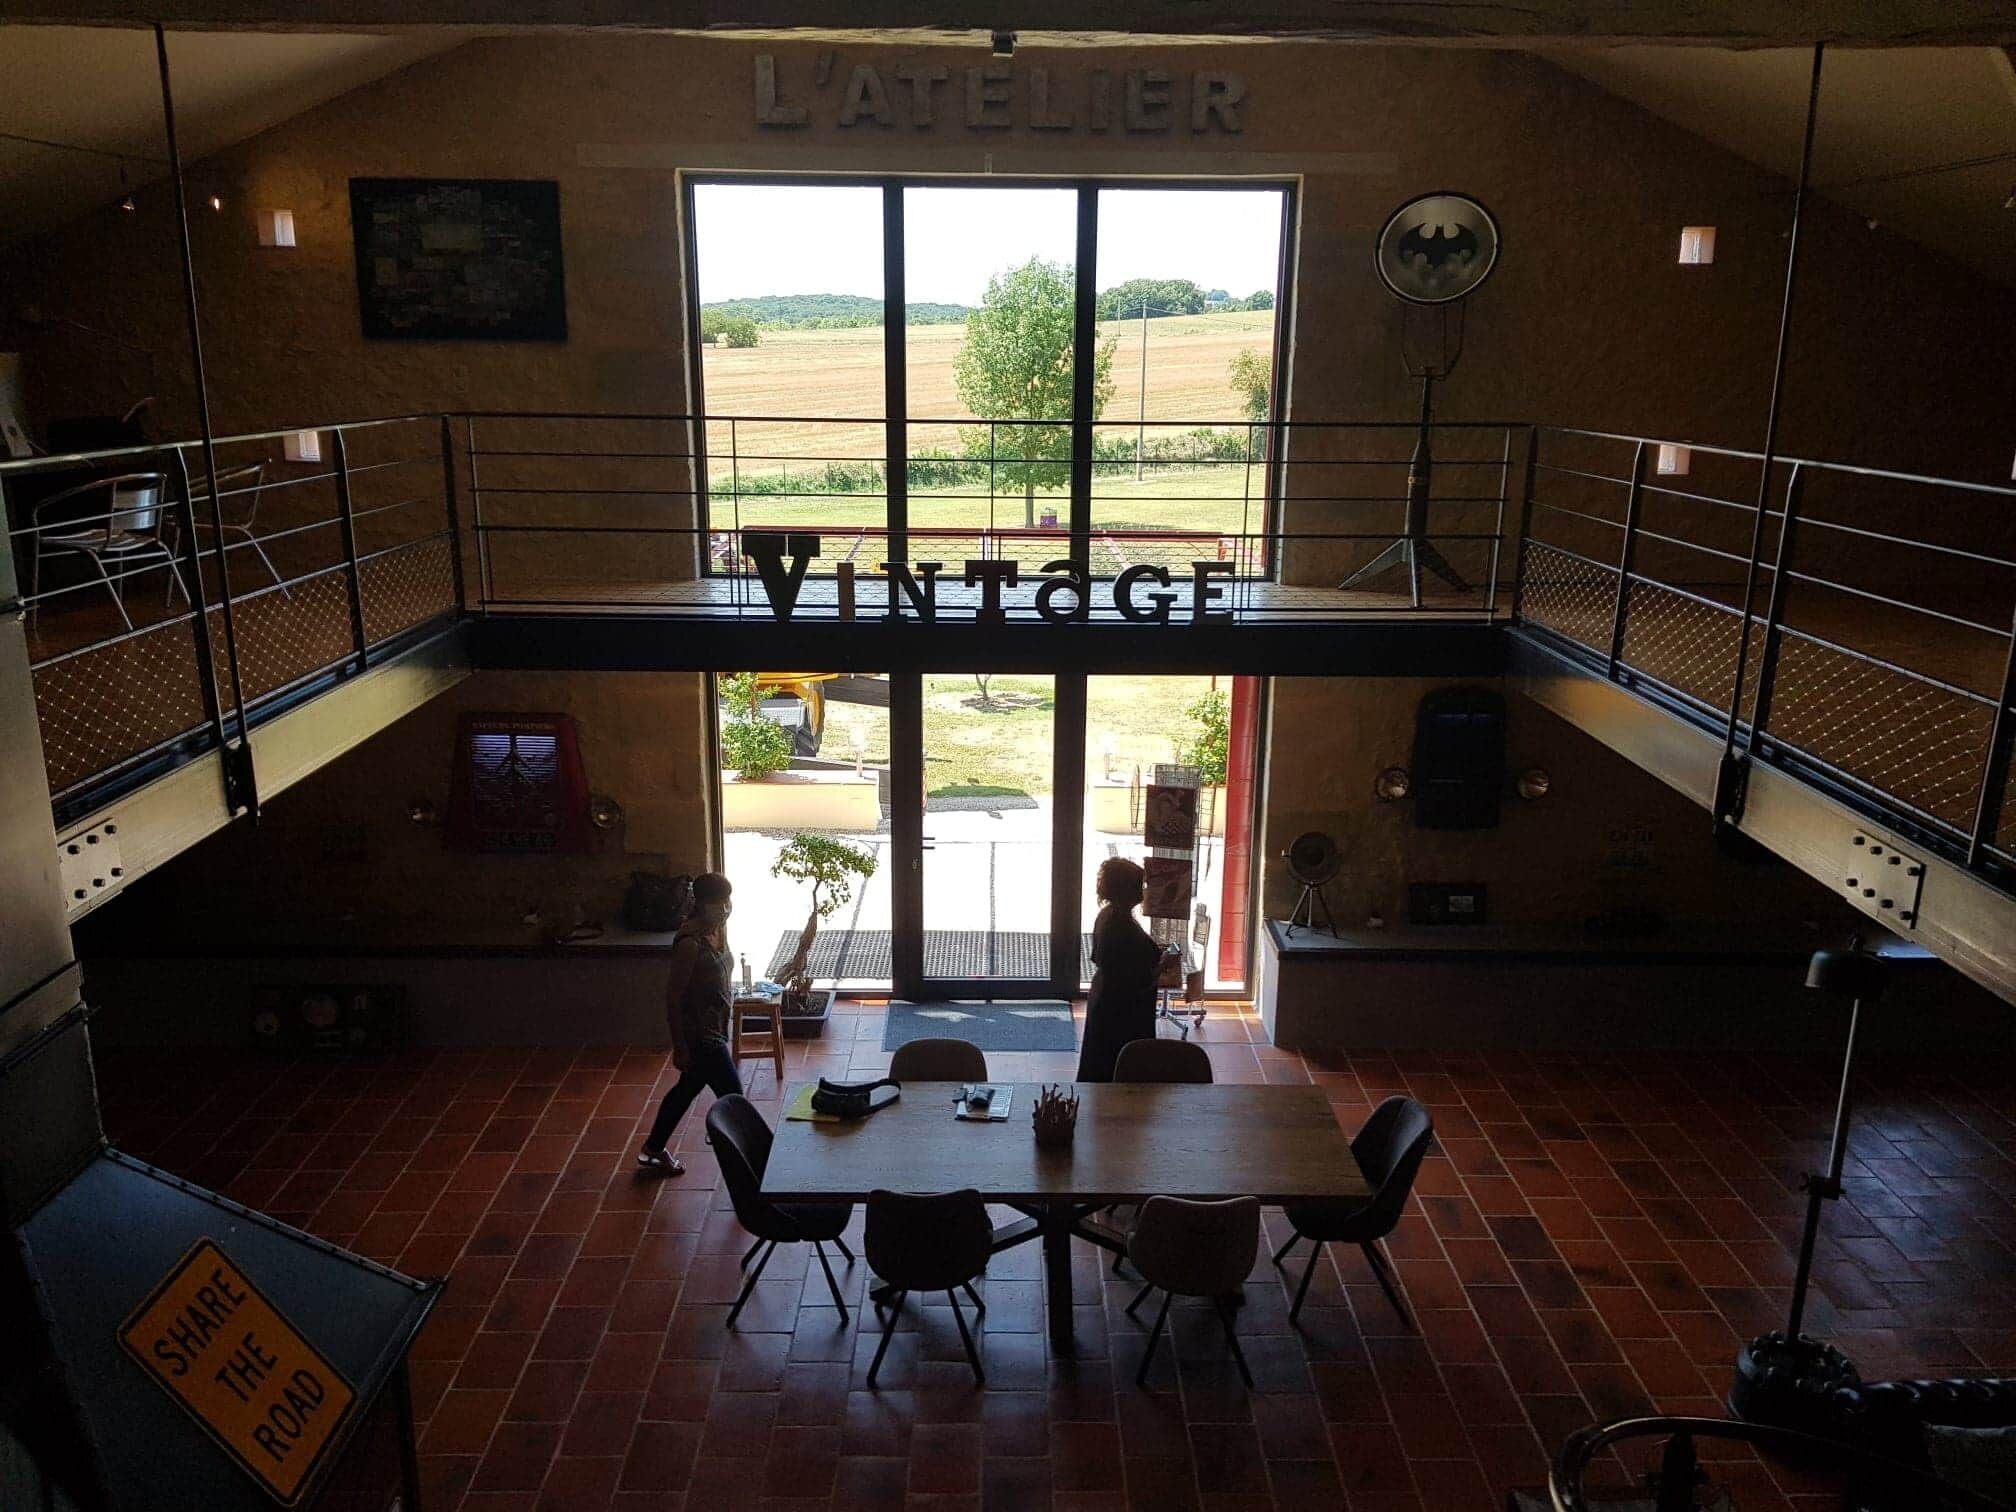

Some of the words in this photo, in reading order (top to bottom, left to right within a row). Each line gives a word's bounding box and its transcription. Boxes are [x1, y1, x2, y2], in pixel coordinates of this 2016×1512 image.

[752, 53, 1246, 133] L'ATELIER
[153, 1267, 246, 1376] SHARE
[214, 1331, 278, 1402] THE
[252, 1368, 325, 1463] ROAD
